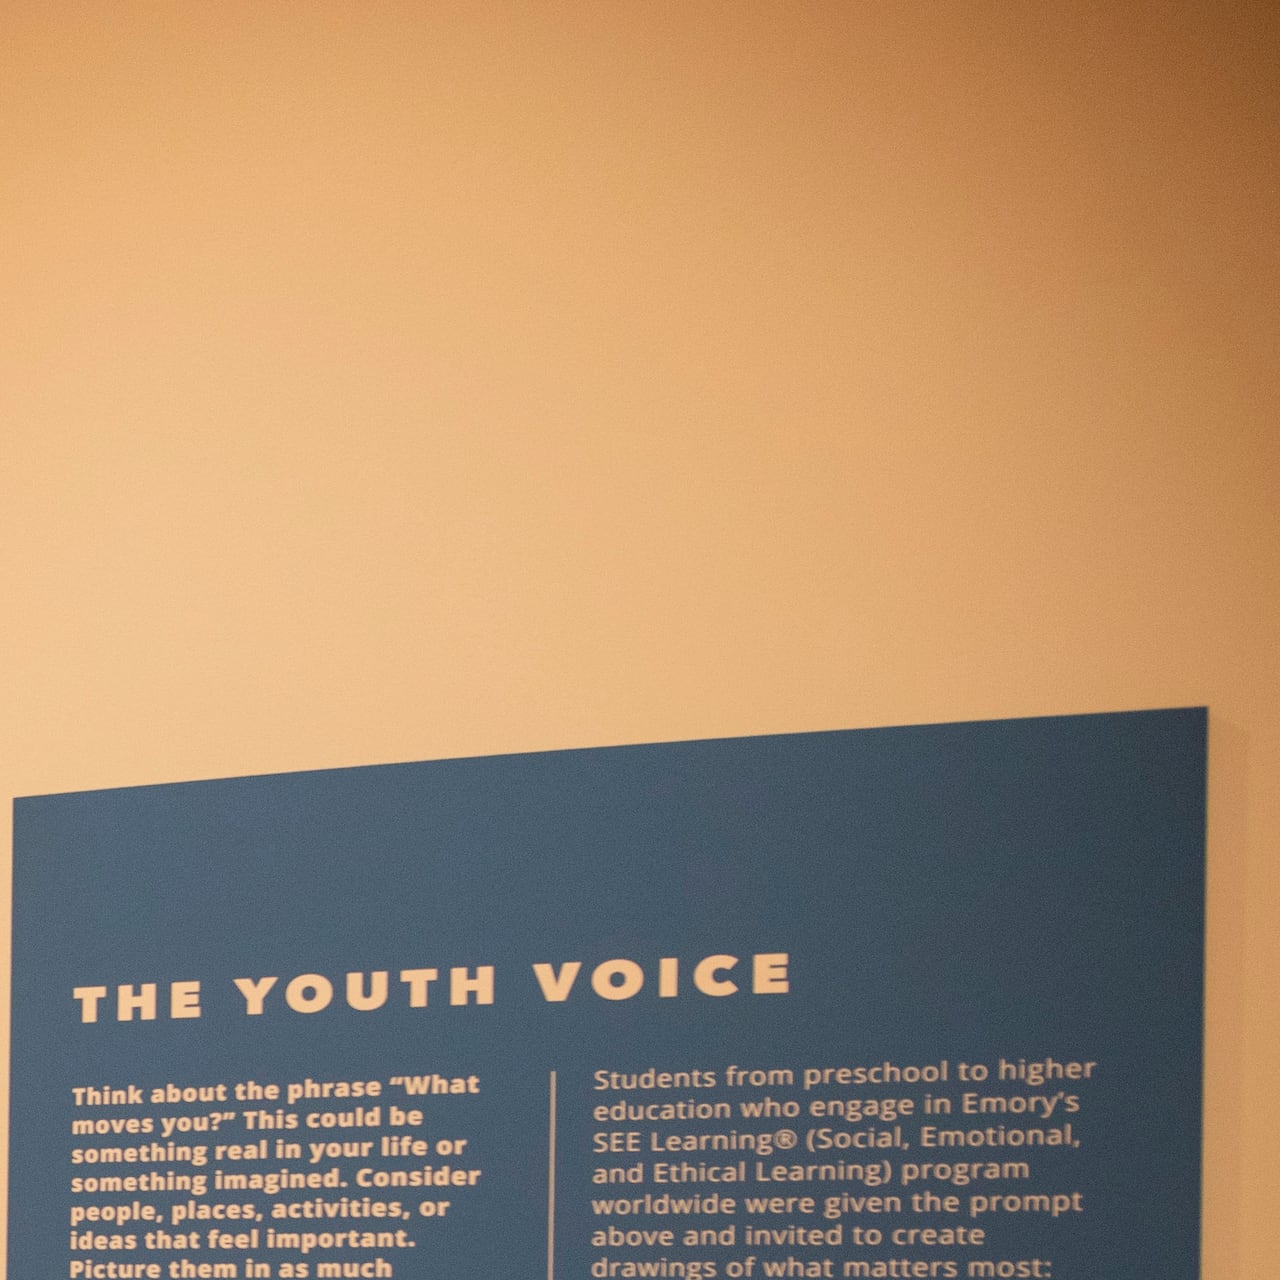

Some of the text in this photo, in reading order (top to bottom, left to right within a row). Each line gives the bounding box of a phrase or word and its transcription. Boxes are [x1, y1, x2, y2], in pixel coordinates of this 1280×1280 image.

[72, 952, 790, 1024] THE YOUTH VOICE
[593, 1057, 1097, 1091] Students from preschool to higher
[71, 1084, 144, 1107] Think
[149, 1083, 228, 1104] about
[234, 1080, 281, 1101] the
[287, 1077, 383, 1105] phrase
[593, 1098, 731, 1122] education
[739, 1096, 801, 1118] who
[809, 1098, 915, 1123] engage
[924, 1093, 952, 1115] in
[71, 1135, 468, 1167] something real in your life or
[592, 1131, 642, 1154] SEE
[806, 1125, 910, 1153] (Social,
[920, 1123, 1081, 1148] Emotional,
[70, 1165, 482, 1196] something imagined. Consider
[592, 1159, 1030, 1187] and Ethical Learning) program
[70, 1196, 451, 1227] people, places, activities, or
[591, 1190, 1084, 1220] worldwide were given the prompt
[69, 1227, 417, 1255] ideas that feel important.
[69, 1257, 393, 1280] Picture them in as much
[725, 1255, 757, 1278] of
[762, 1256, 834, 1278] what
[843, 1258, 958, 1278] matters
[967, 1258, 1052, 1278] most:
